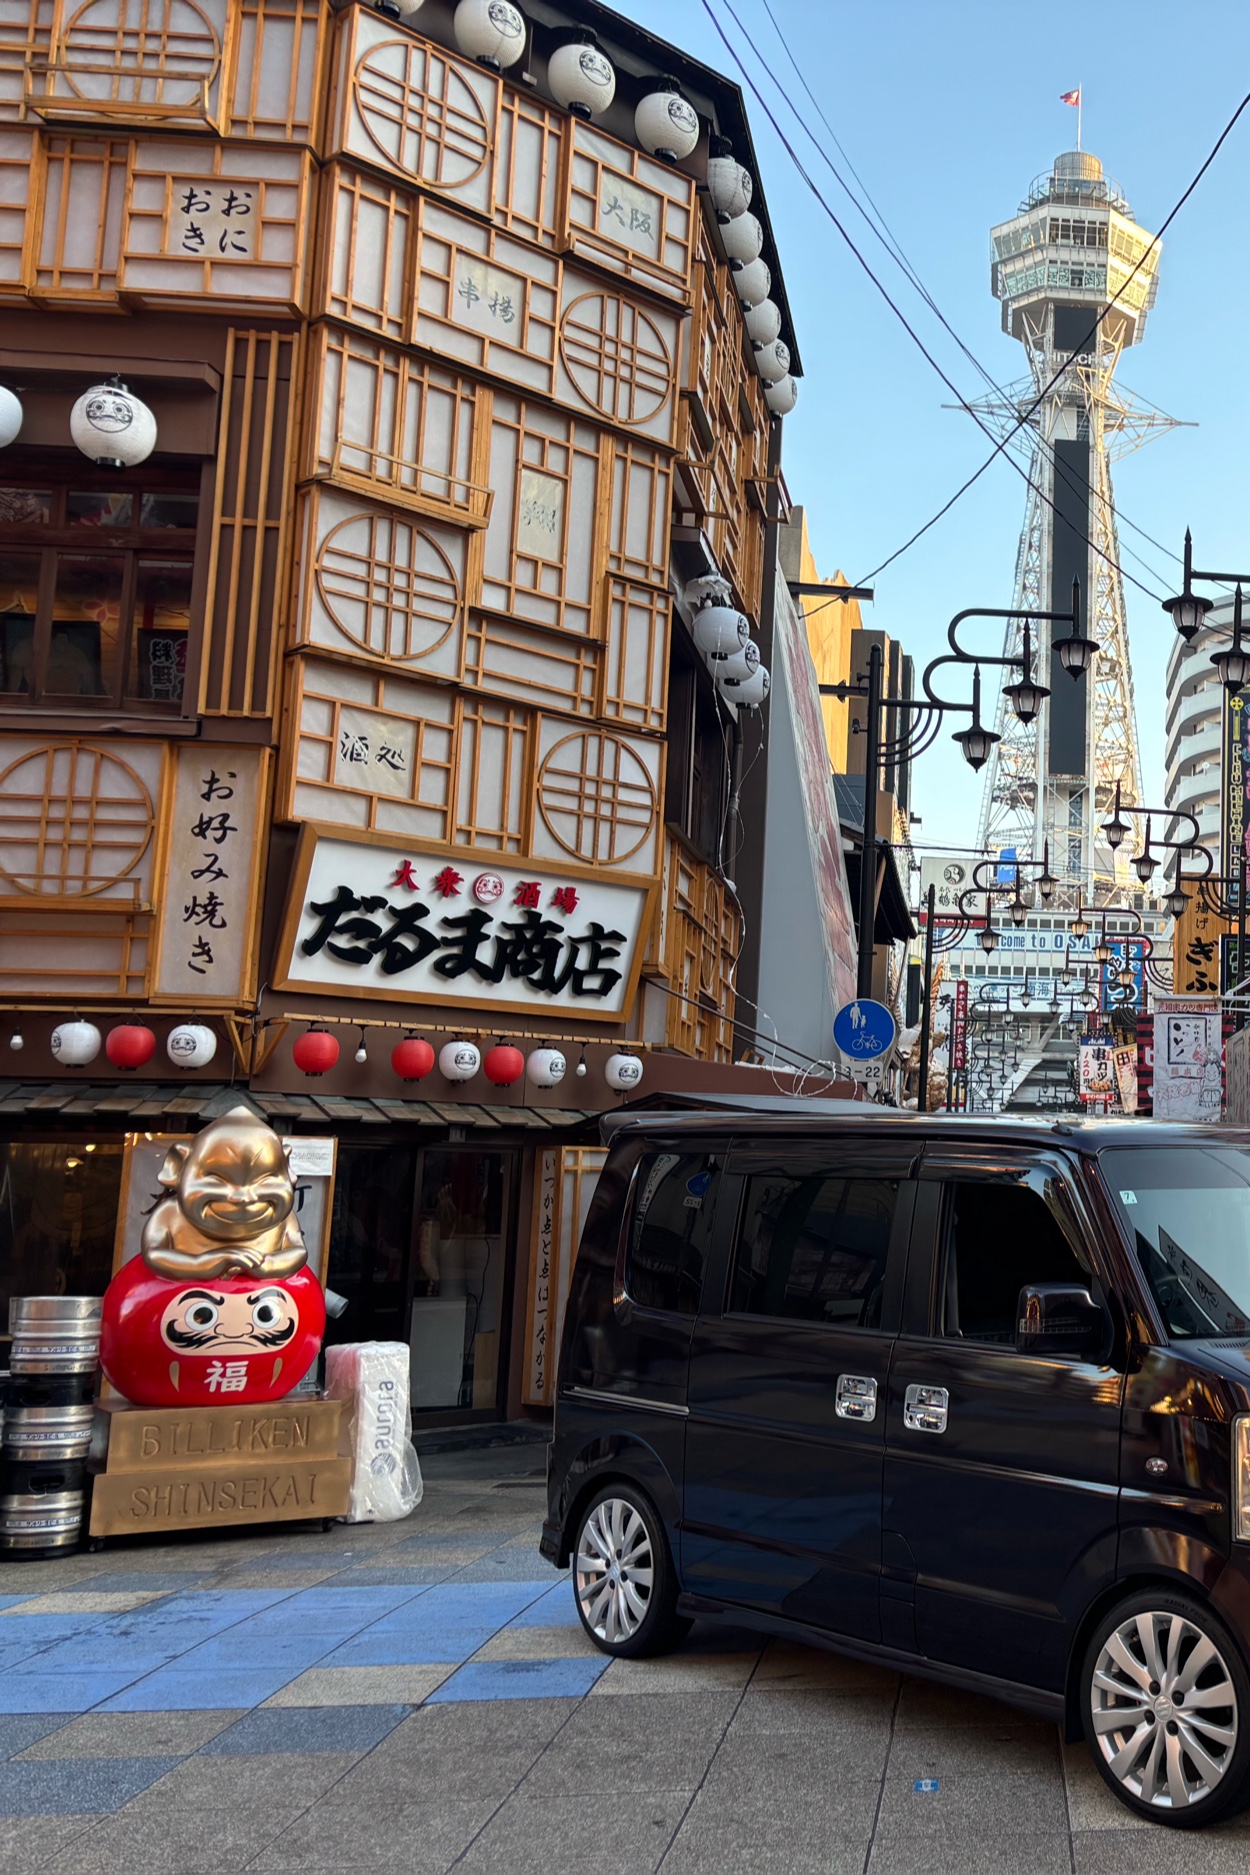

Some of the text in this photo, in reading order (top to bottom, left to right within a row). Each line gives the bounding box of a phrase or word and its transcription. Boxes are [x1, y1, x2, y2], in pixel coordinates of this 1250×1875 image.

[601, 196, 655, 241] 大阪
[340, 730, 407, 772] 酒処
[183, 769, 238, 975] お好み焼き
[301, 885, 628, 997] だるま商店
[1031, 933, 1046, 948] to
[1185, 937, 1219, 992] ぎふ
[203, 1360, 249, 1393] 福
[140, 1415, 311, 1460] BILLIKEN
[130, 1473, 317, 1520] SHINSEKAI
